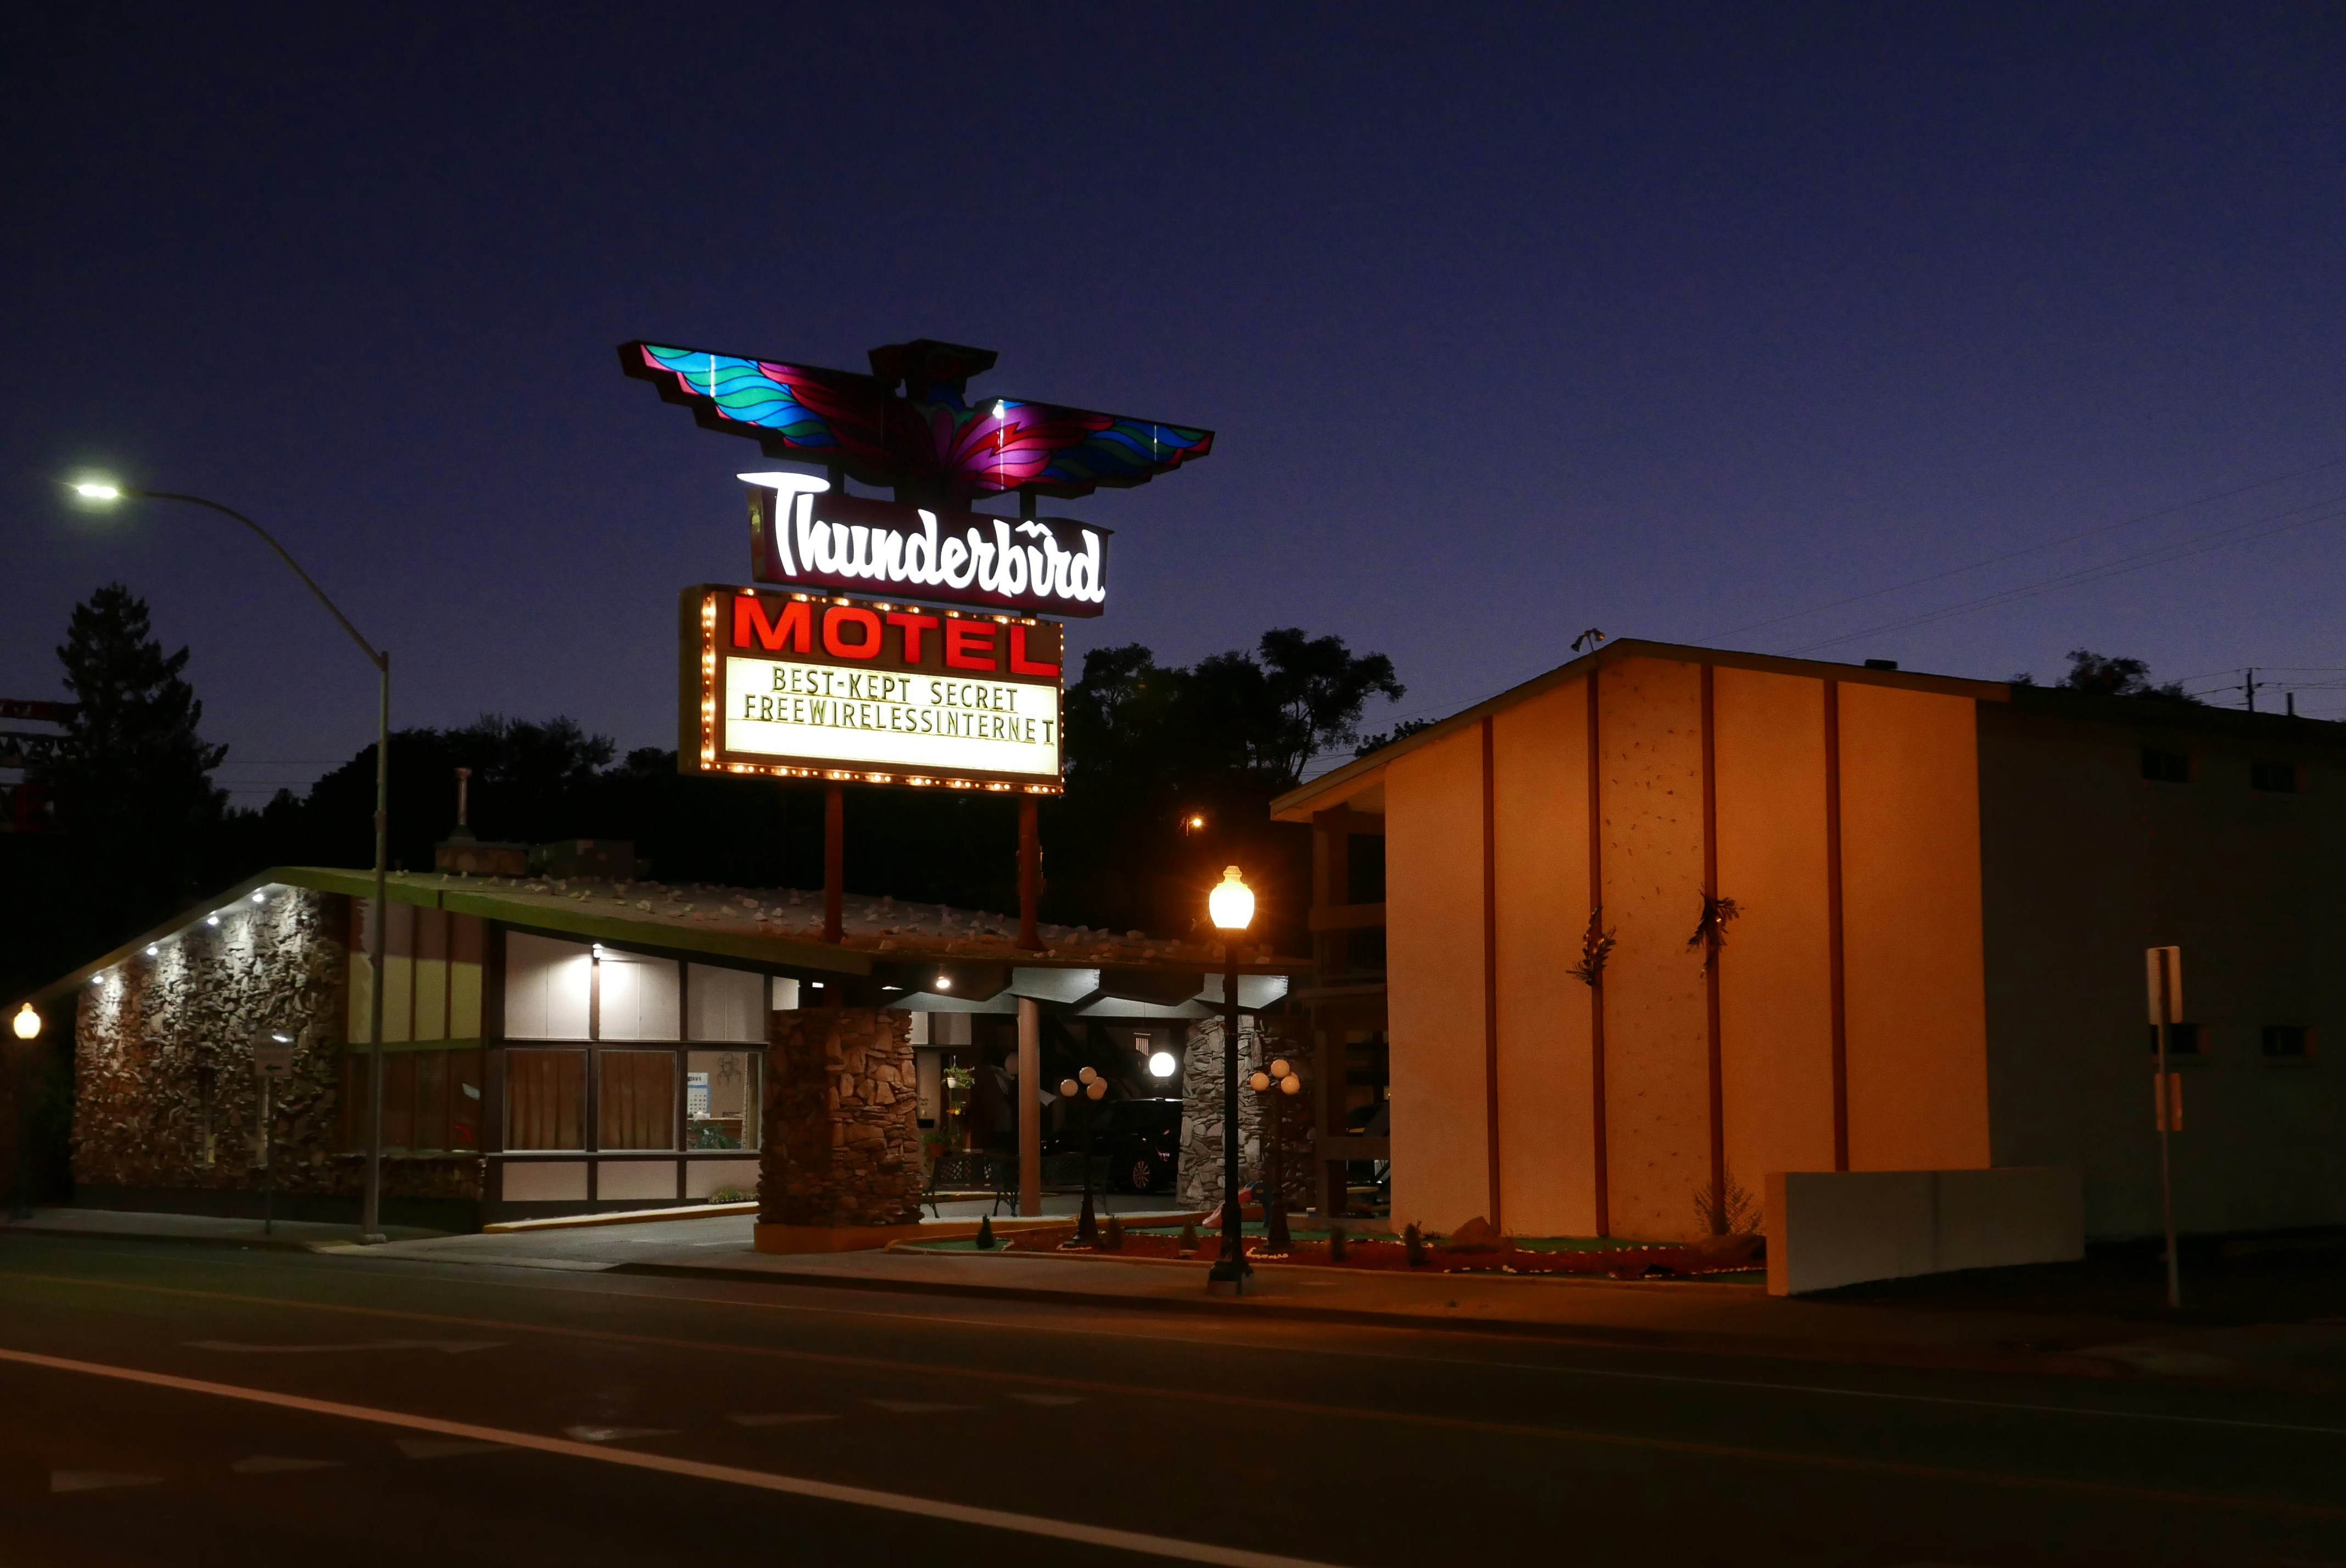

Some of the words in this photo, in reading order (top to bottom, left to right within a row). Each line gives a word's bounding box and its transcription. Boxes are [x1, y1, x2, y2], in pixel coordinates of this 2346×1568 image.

[736, 472, 1105, 603] Thunderbird
[734, 596, 1059, 677] MOTEL
[772, 666, 911, 702] BEST-KEPT
[930, 680, 1018, 711] SECRET
